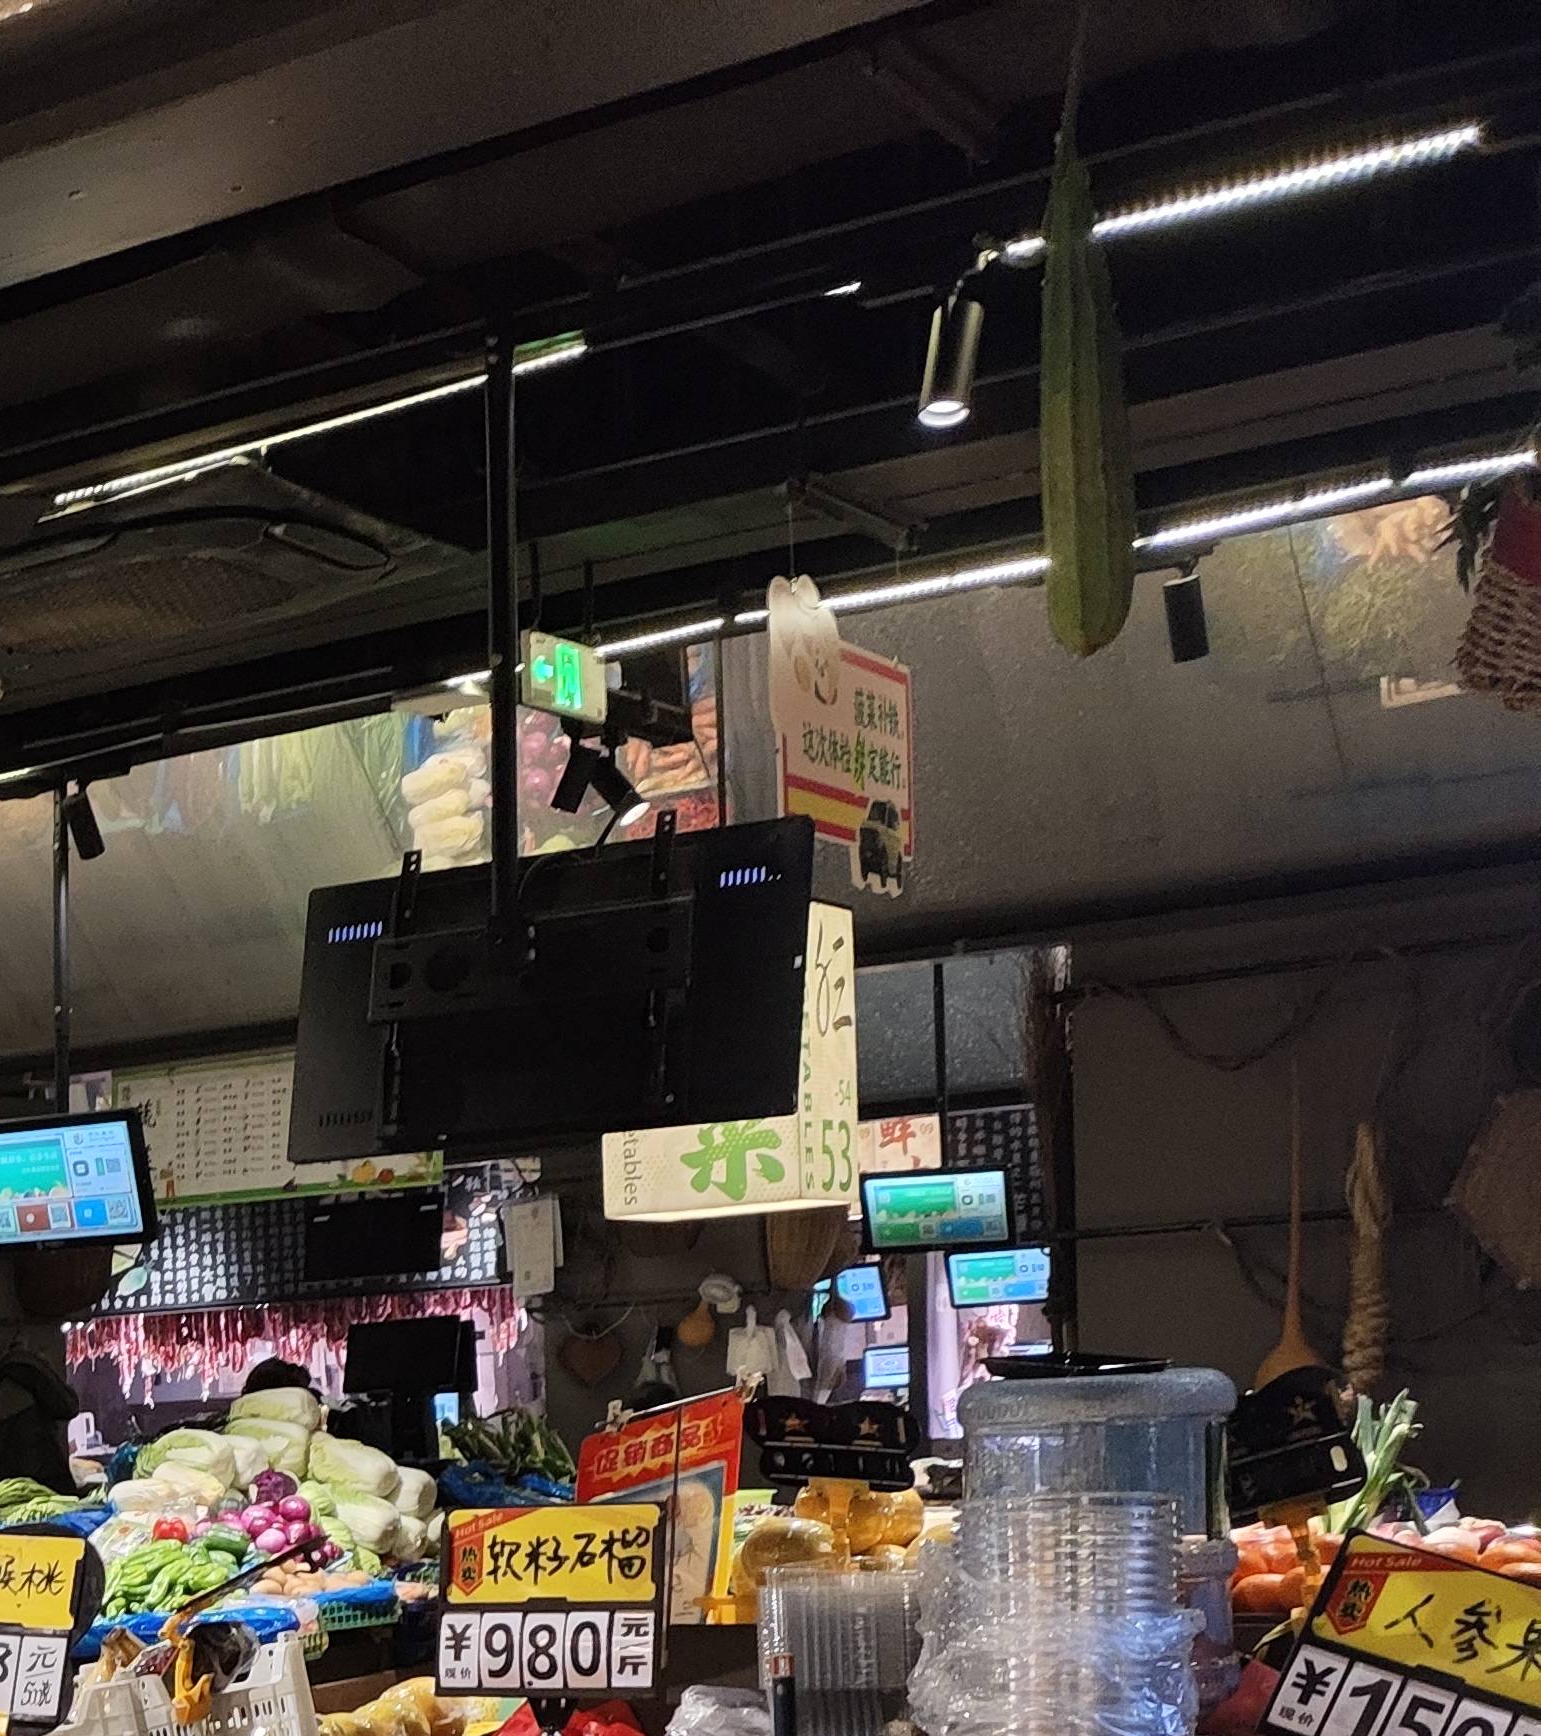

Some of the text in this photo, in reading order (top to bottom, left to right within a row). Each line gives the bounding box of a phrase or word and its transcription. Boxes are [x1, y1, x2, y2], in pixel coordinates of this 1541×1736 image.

[820, 1118, 853, 1193] 53
[595, 1422, 703, 1475] 促销商品
[1277, 1705, 1315, 1728] 现价
